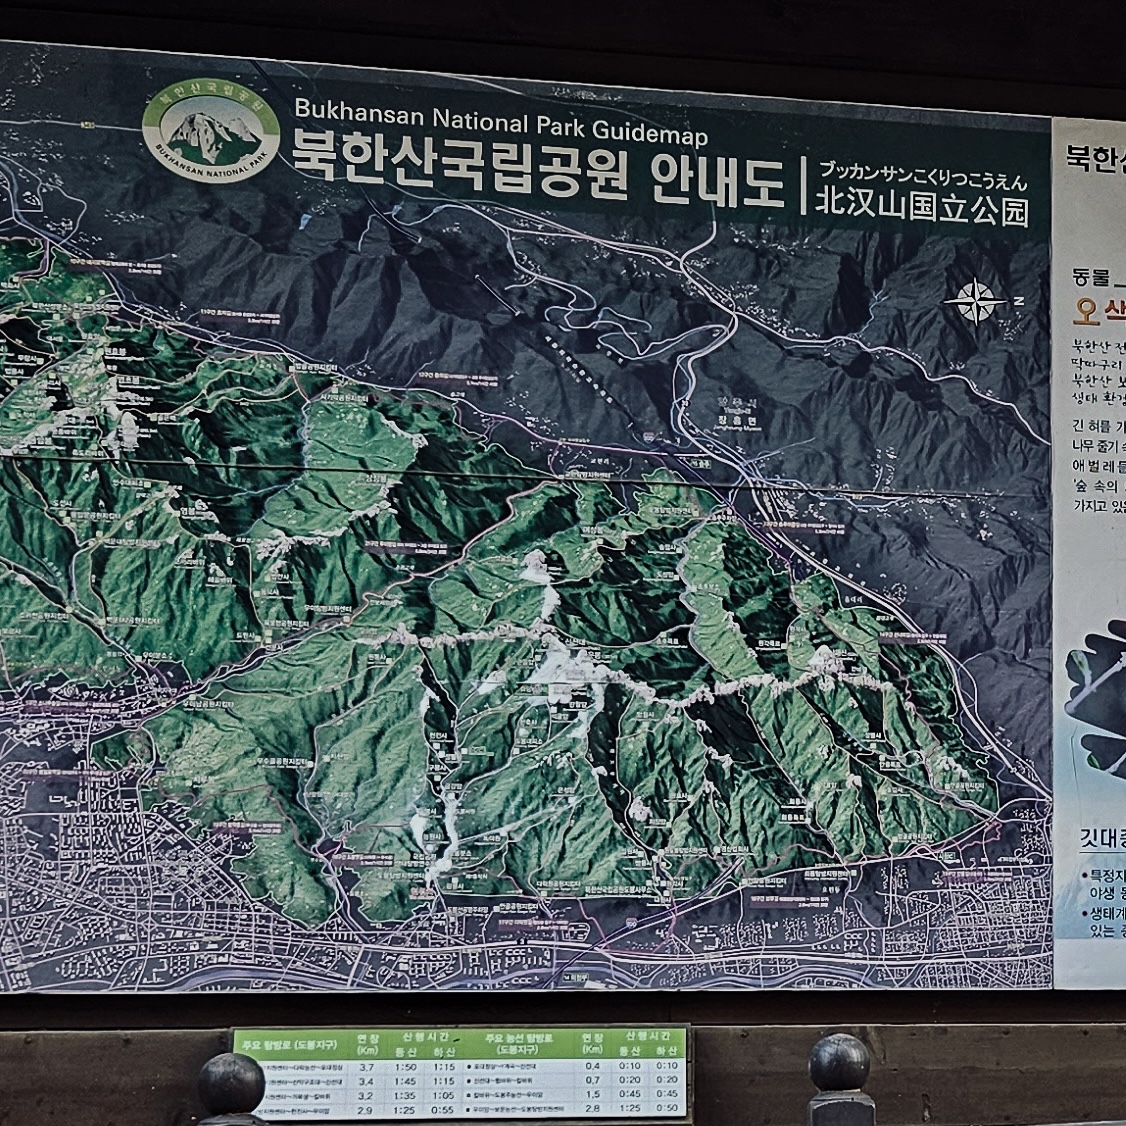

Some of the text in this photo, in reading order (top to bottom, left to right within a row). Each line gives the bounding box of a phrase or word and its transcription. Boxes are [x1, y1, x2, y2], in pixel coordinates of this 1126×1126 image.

[295, 97, 709, 147] Bukhansan National Park Guidemap
[155, 143, 268, 178] BUKHANSAN NATIONAL PARK
[292, 127, 785, 209] 북한산국립공원 안내도
[819, 160, 1028, 193] ブッカンサンこくりつこうえん
[814, 184, 1030, 229] 北汉山国立公园
[1072, 267, 1110, 288] 동물
[1072, 338, 1111, 354] 북한산
[1071, 357, 1122, 371] 딱따구리
[1072, 373, 1112, 388] 북한산
[1072, 392, 1098, 405] 생태
[1072, 419, 1084, 433] 긴
[1072, 439, 1094, 453] 나무
[1097, 440, 1118, 453] 줄기
[1094, 480, 1118, 494] 속의
[1074, 499, 1107, 513] 가지고
[1090, 886, 1115, 900] 야생
[1090, 924, 1115, 938] 있는
[357, 1045, 379, 1056] (Km)
[582, 1044, 603, 1055] (Km)
[395, 1063, 417, 1071] 1:50
[434, 1063, 456, 1071] 1:15
[618, 1061, 641, 1070] 0:10
[656, 1061, 678, 1070] 0:10
[394, 1077, 416, 1086] 1:45
[433, 1077, 455, 1086] 1:15
[619, 1076, 641, 1084] 0:20
[656, 1075, 678, 1084] 0:20
[394, 1092, 416, 1100] 1:35
[433, 1091, 455, 1100] 1:05
[619, 1090, 641, 1098] 0:45
[656, 1090, 678, 1098] 0:45
[393, 1106, 415, 1115] 1:25
[431, 1106, 454, 1114] 0:55
[620, 1104, 641, 1112] 1:25
[656, 1104, 678, 1112] 0:50
